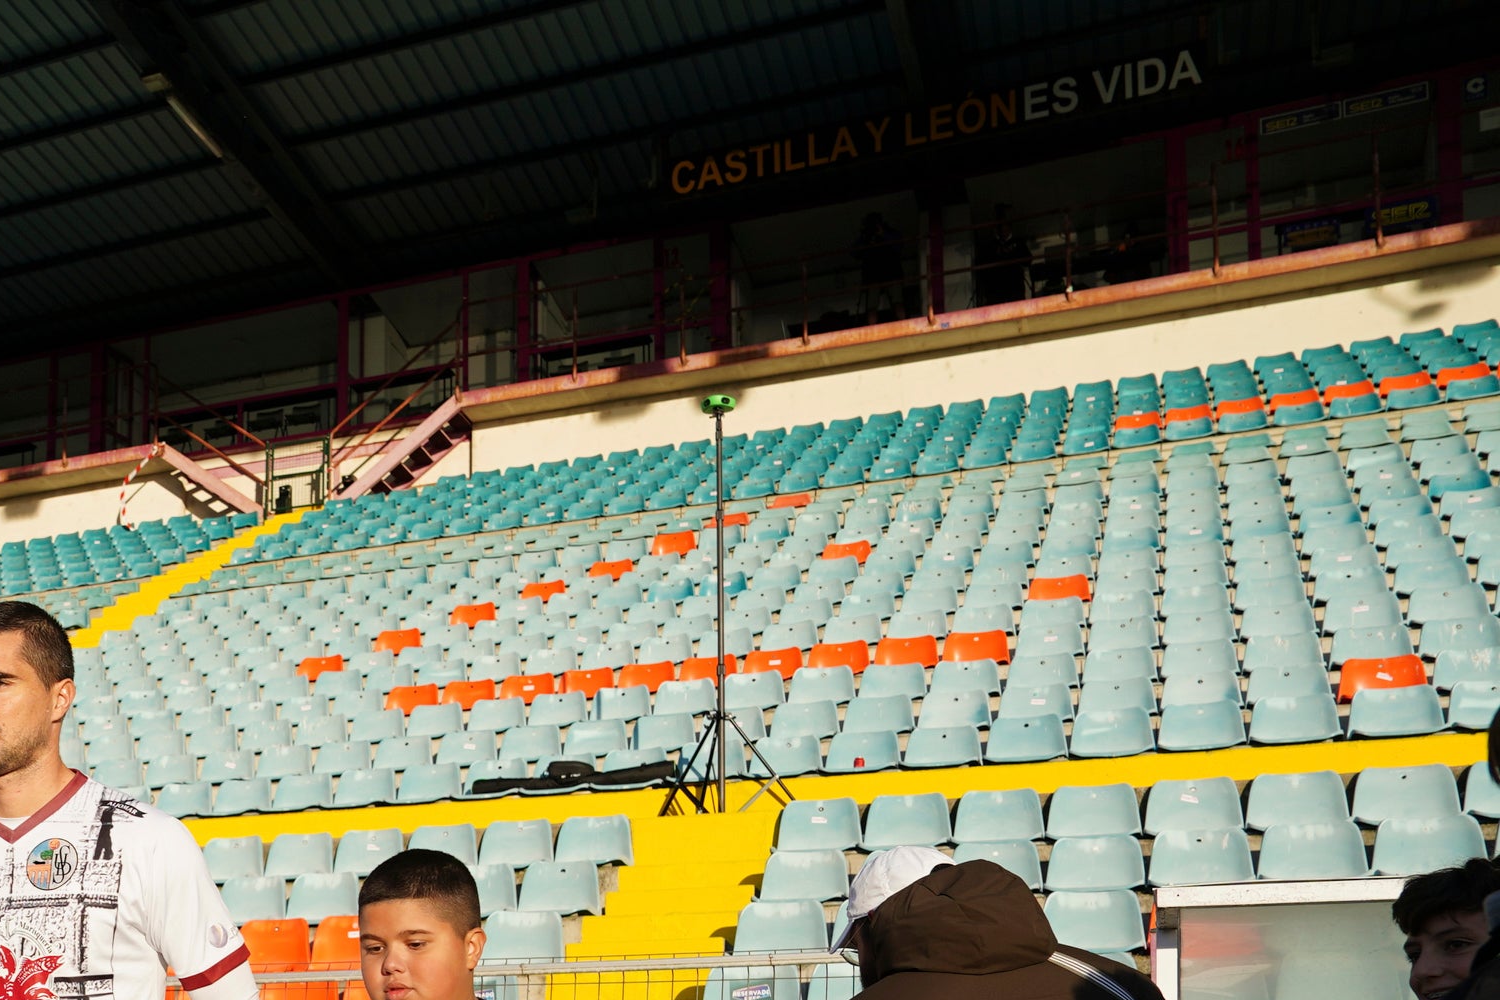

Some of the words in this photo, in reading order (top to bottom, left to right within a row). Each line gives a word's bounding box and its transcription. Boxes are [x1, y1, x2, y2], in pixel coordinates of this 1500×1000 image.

[671, 126, 859, 195] CASTILLA
[864, 116, 893, 154] Y
[904, 88, 1018, 148] LEÓN
[1023, 77, 1081, 121] ES
[1092, 49, 1204, 106] VIDA
